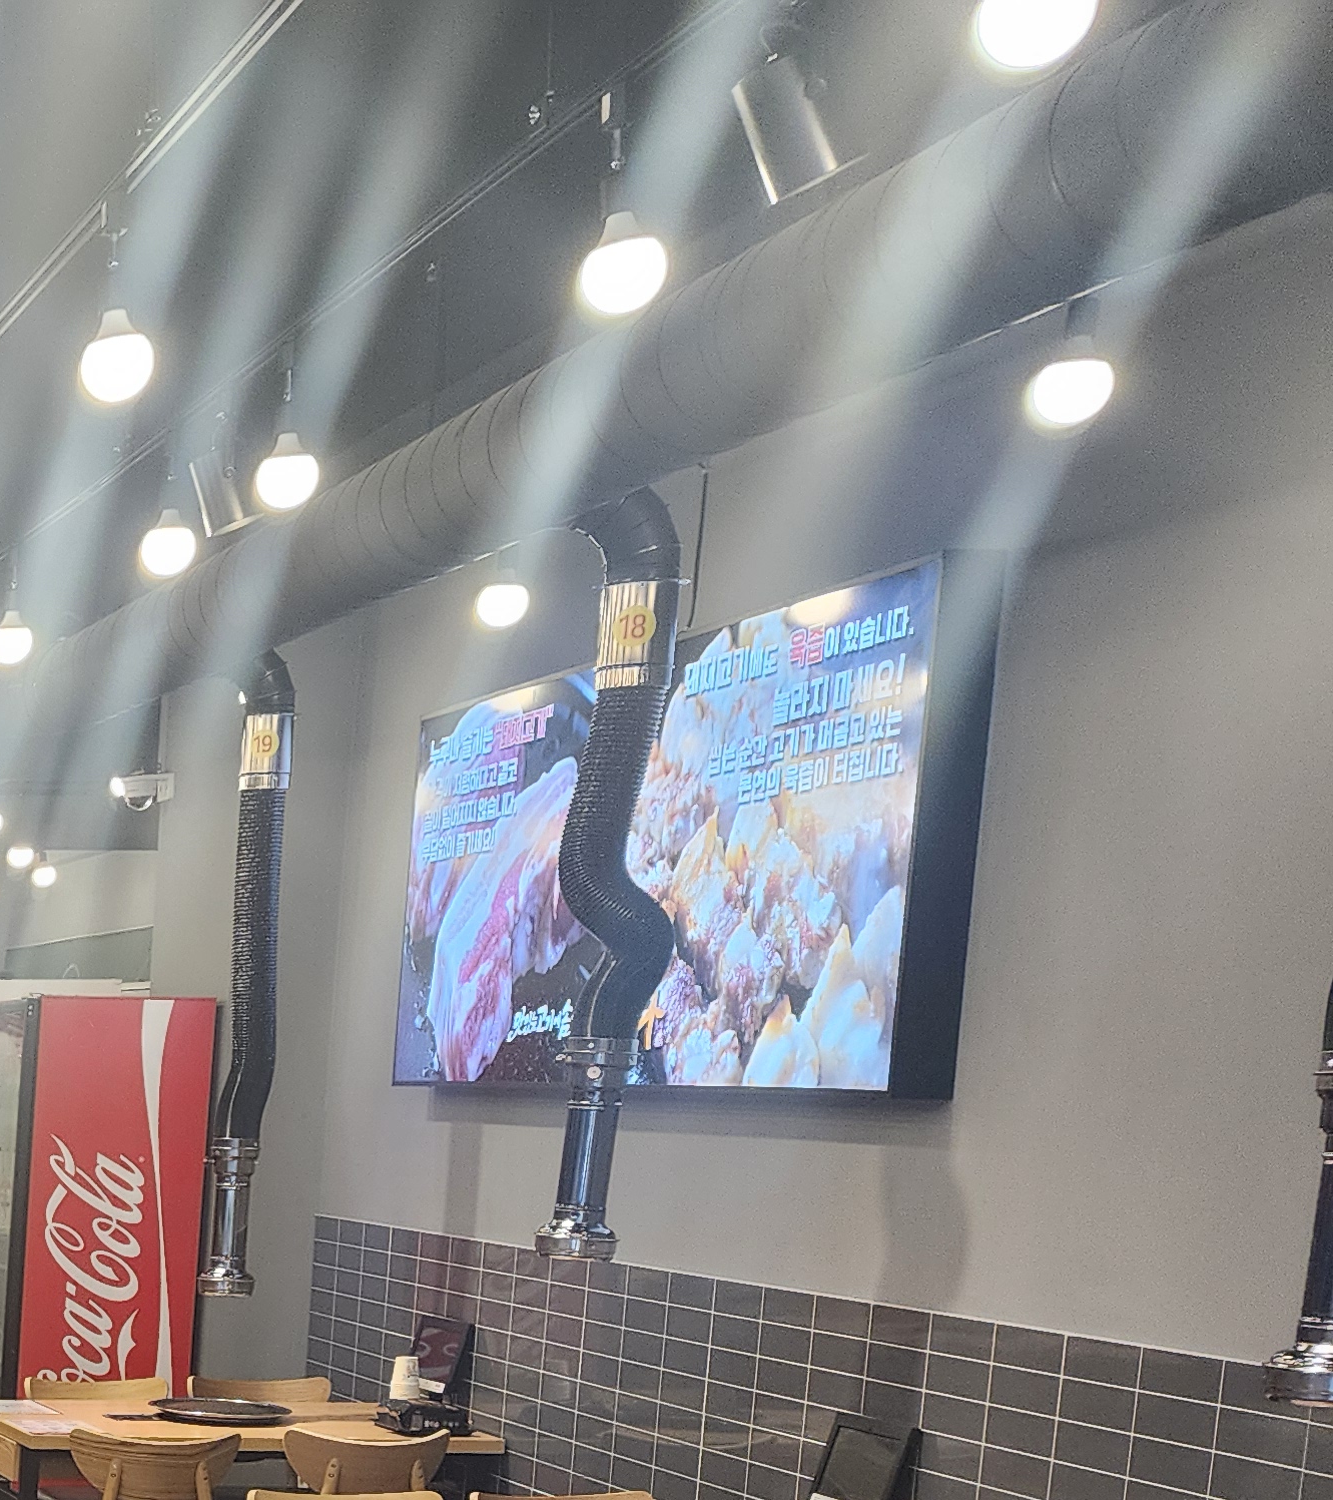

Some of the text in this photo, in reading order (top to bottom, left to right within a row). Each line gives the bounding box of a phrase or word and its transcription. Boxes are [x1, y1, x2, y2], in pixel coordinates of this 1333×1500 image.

[619, 614, 646, 640] 18
[684, 605, 915, 698] 돼지고기에도 육즙이 있습니다.
[772, 653, 907, 728] 놀라지 마세요!
[252, 734, 274, 754] 19
[737, 735, 768, 770] 순간
[769, 721, 816, 763] 고기가
[817, 712, 865, 752] 머금고
[869, 704, 903, 740] 있는
[737, 742, 905, 805] 본연의 육즙이 터집니다.
[36, 1133, 145, 1385] ca-Cola
